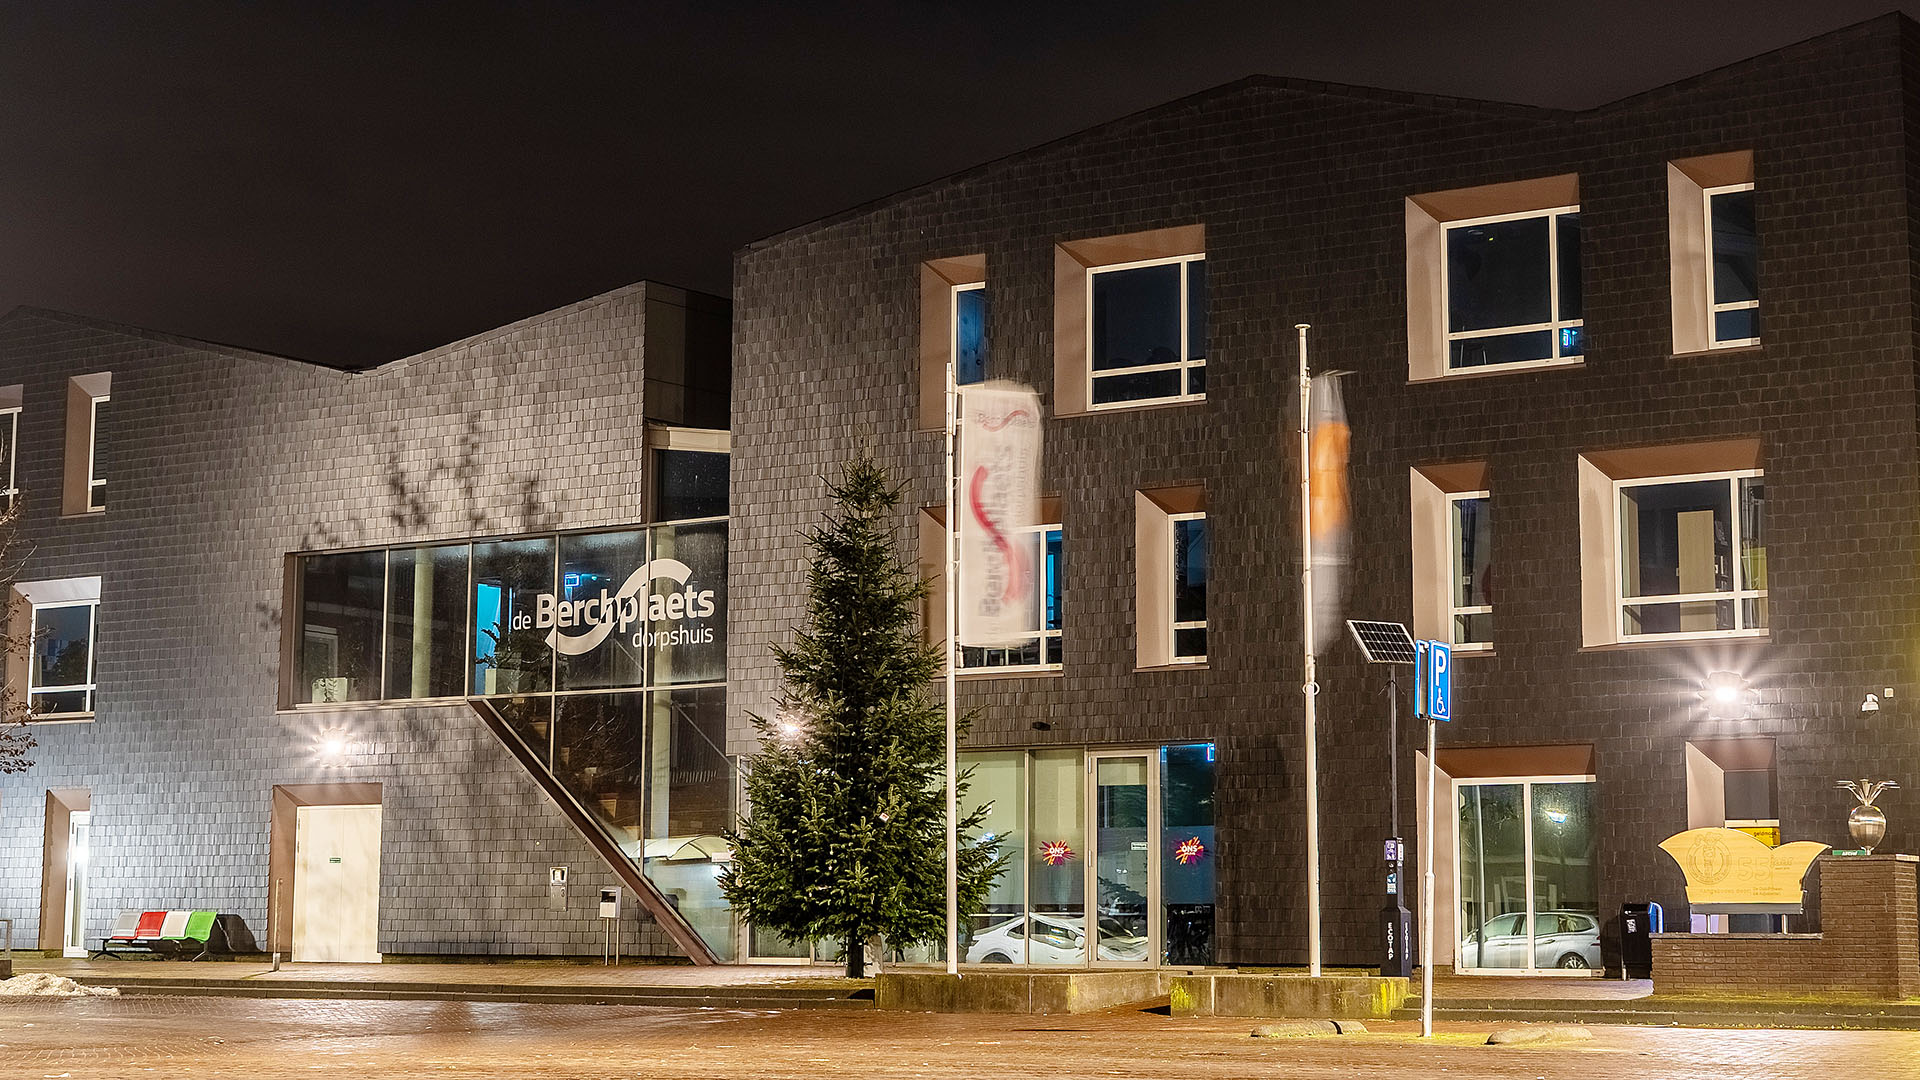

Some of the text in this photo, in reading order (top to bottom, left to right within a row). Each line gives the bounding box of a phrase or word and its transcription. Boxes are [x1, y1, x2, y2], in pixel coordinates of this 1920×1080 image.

[512, 584, 715, 634] de Berchplaets
[632, 624, 714, 651] dorpshuis
[1435, 648, 1447, 687] P
[1181, 845, 1198, 853] ONS
[1737, 856, 1770, 881] 55
